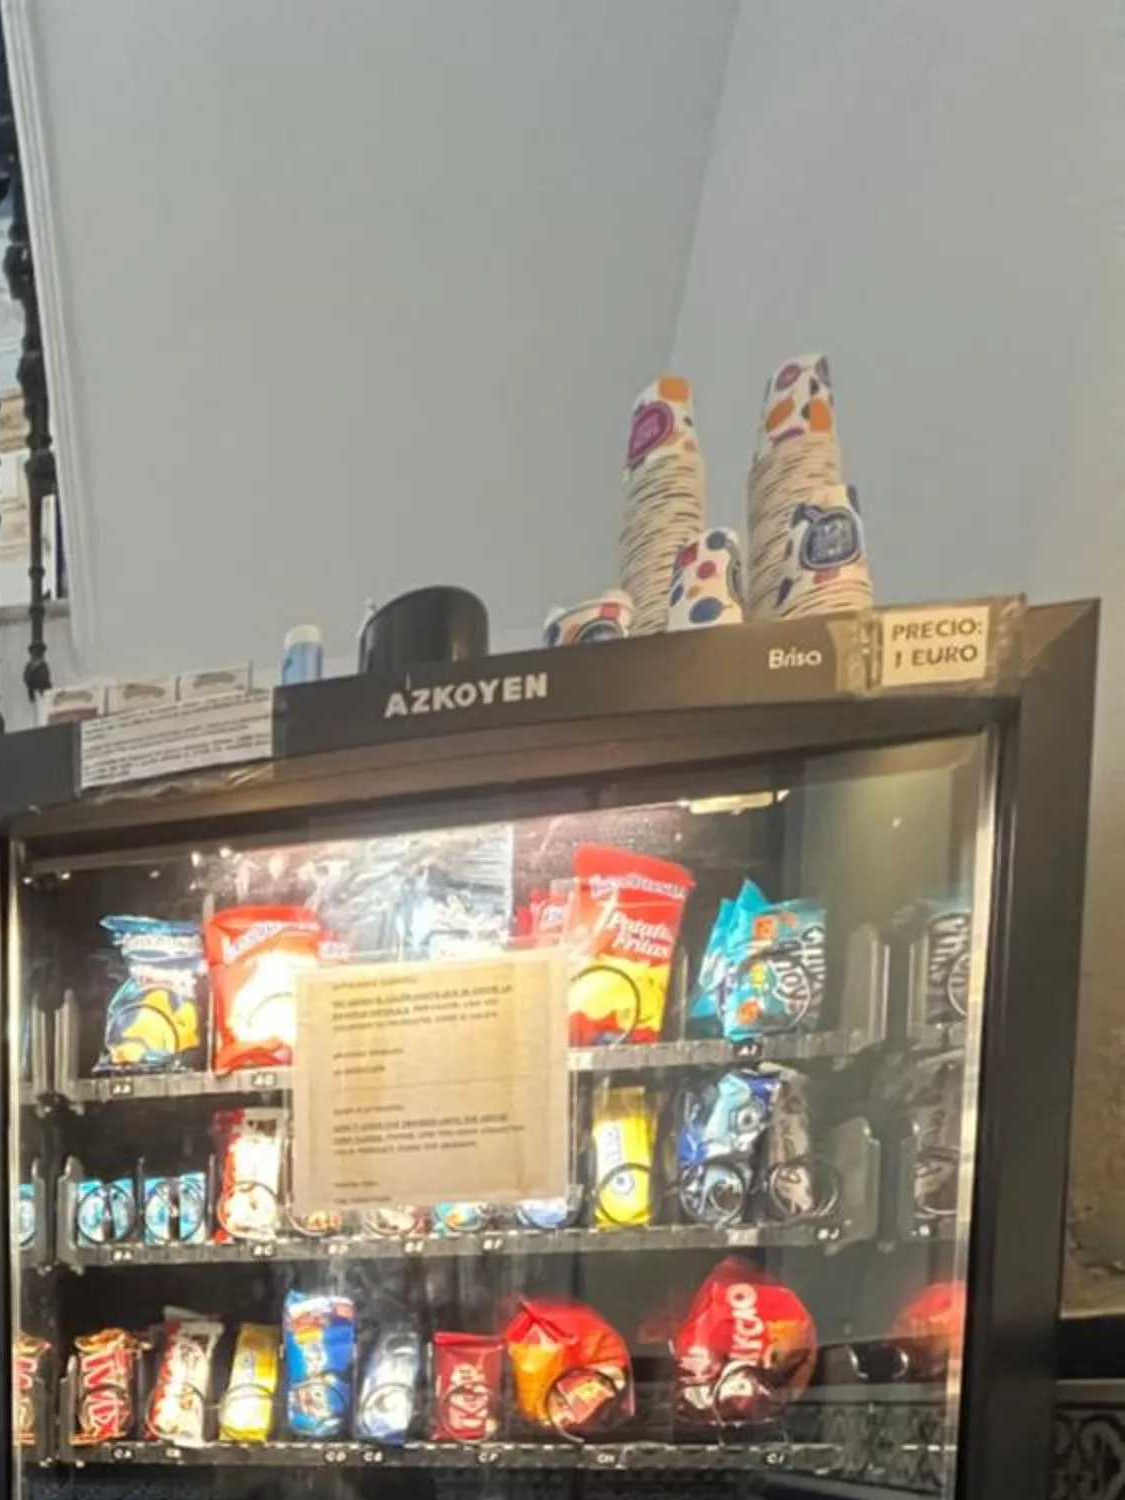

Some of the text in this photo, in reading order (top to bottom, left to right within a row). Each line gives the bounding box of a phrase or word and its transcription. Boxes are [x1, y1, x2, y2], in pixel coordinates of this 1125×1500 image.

[891, 616, 983, 642] PRECIO:
[911, 643, 979, 667] EURO
[384, 671, 549, 718] AZKOYEN
